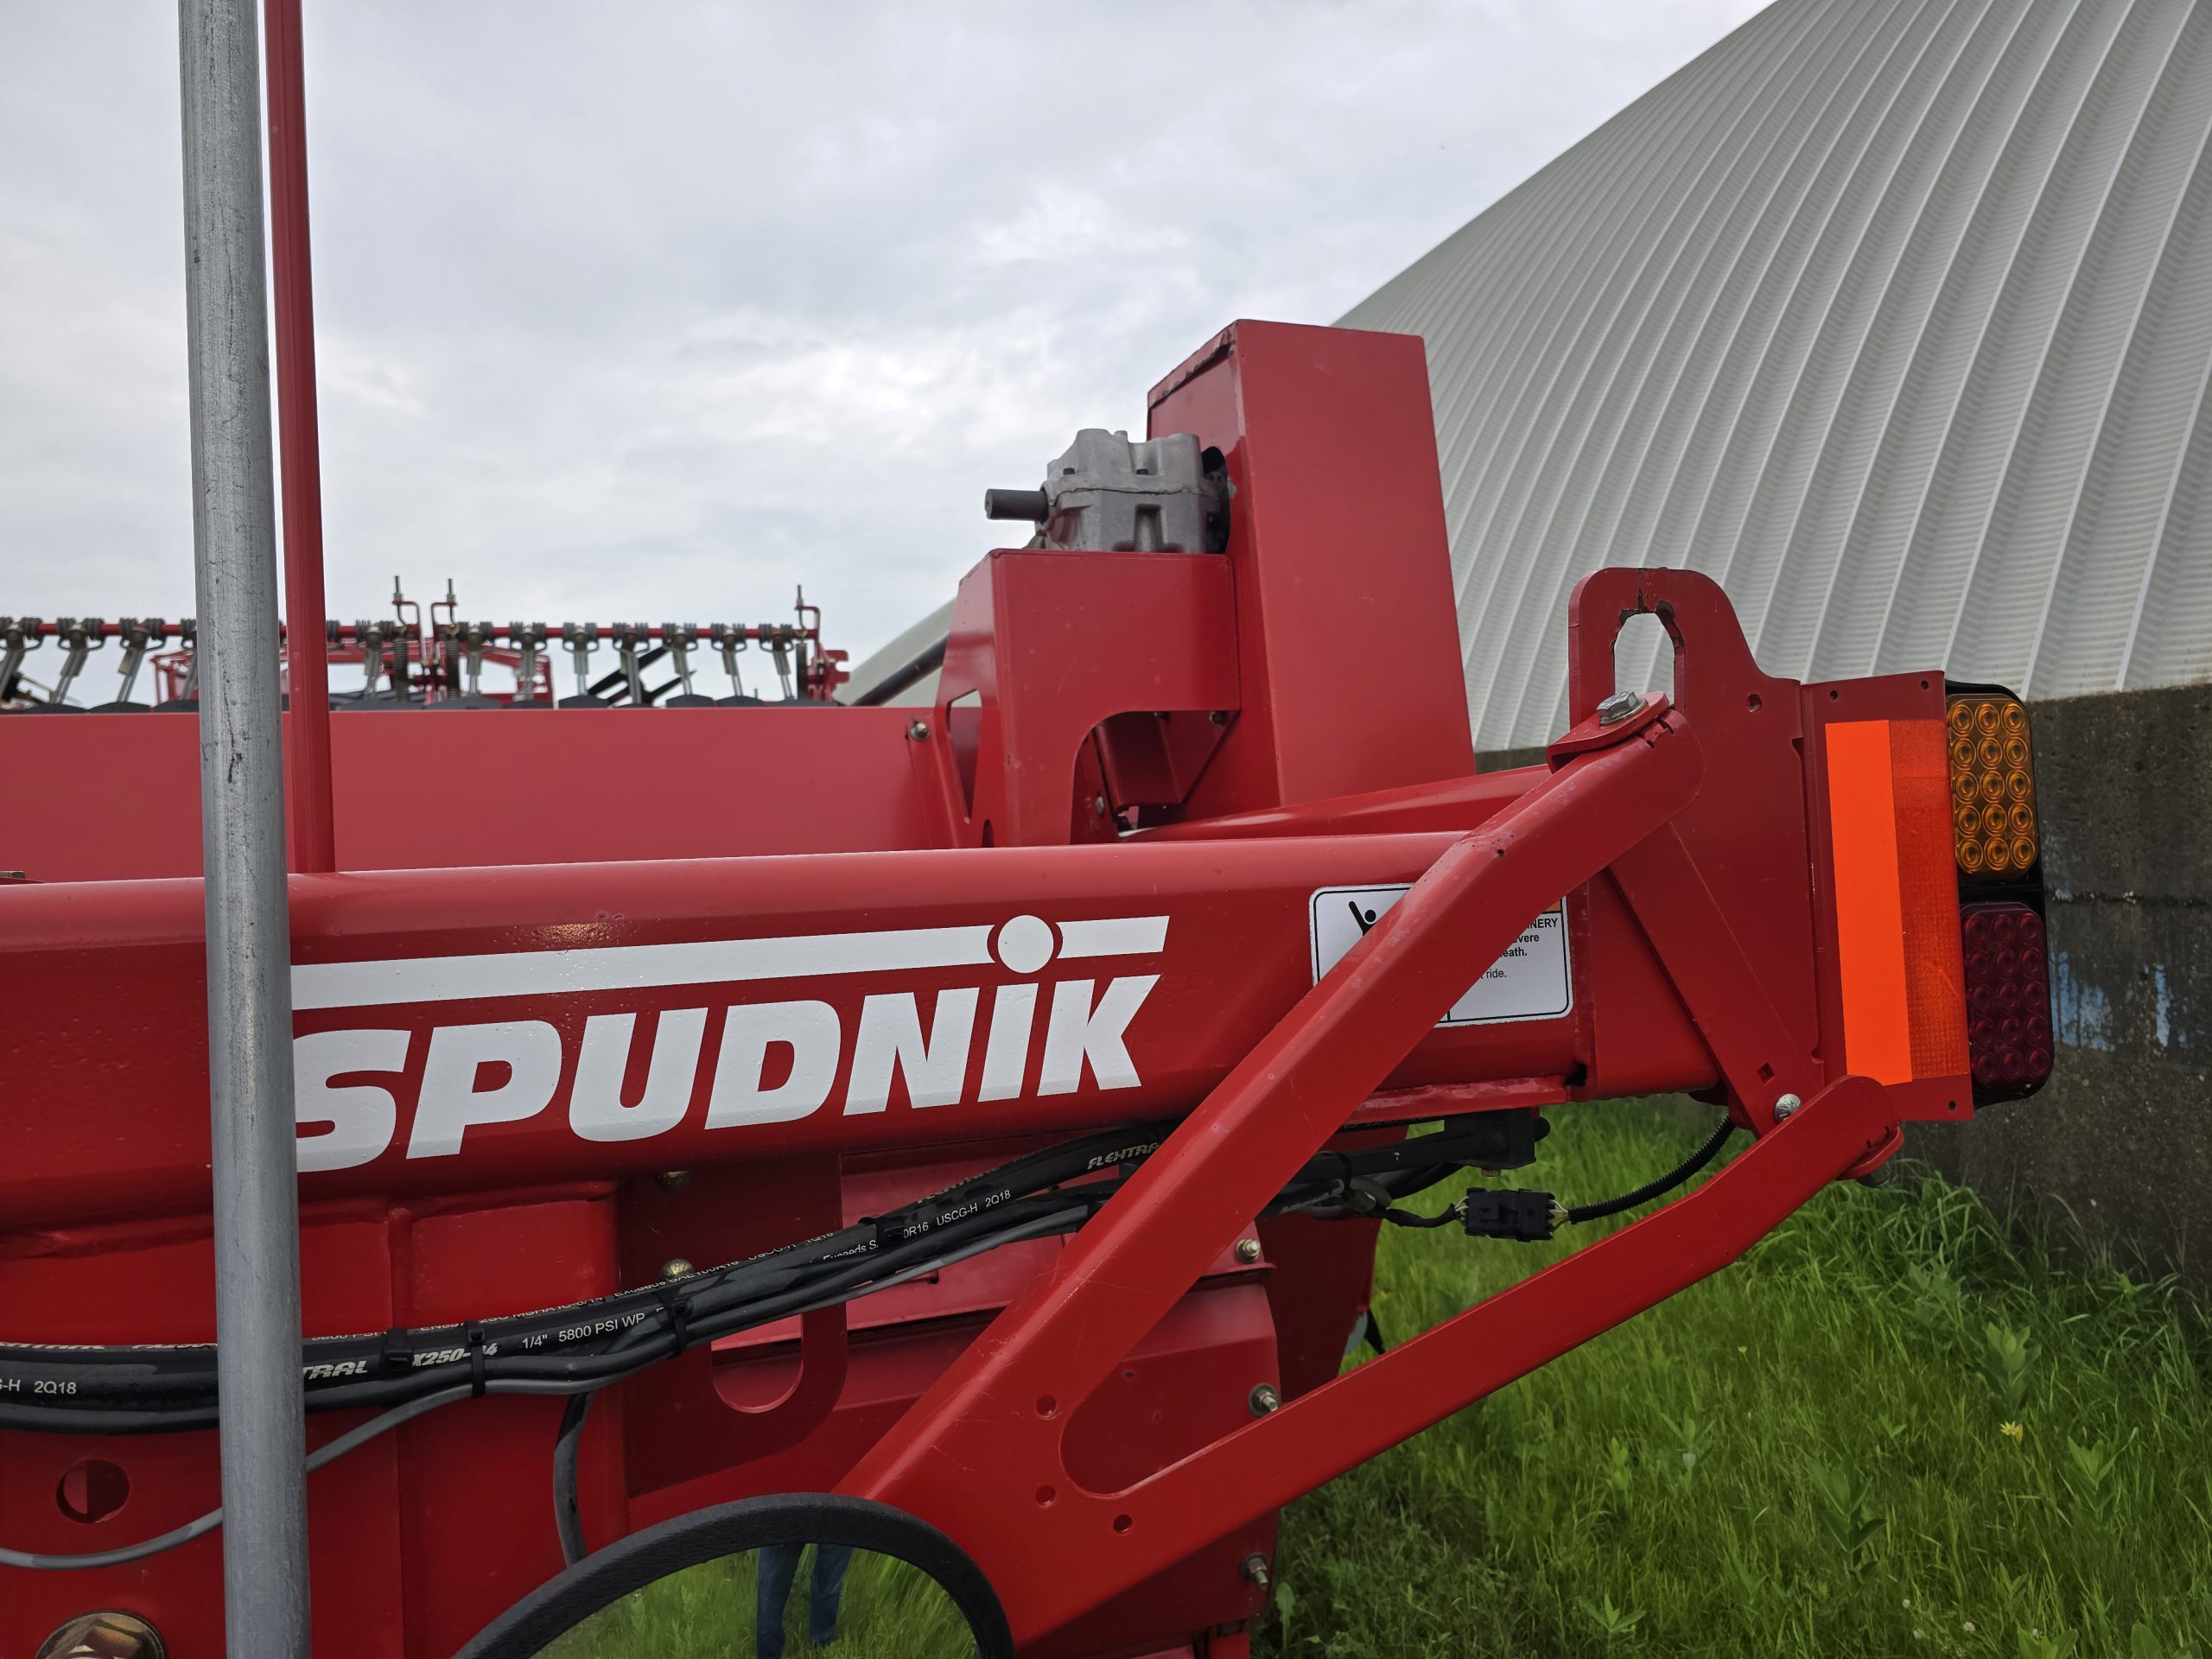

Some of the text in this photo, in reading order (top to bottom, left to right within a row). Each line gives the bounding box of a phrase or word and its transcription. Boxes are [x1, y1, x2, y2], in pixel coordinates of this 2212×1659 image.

[1527, 918, 1559, 929] NERY
[1500, 946, 1528, 957] eath.
[1485, 968, 1508, 979] ride.
[294, 915, 1161, 1173] SPUDNIK
[936, 1202, 978, 1226] USCG-H
[985, 1189, 1011, 1207] 2Q18
[412, 1342, 499, 1368] X250-4
[558, 1325, 592, 1343] 5800
[595, 1319, 619, 1335] PSI
[621, 1313, 645, 1328] WP
[34, 1380, 77, 1395] 2Q18
